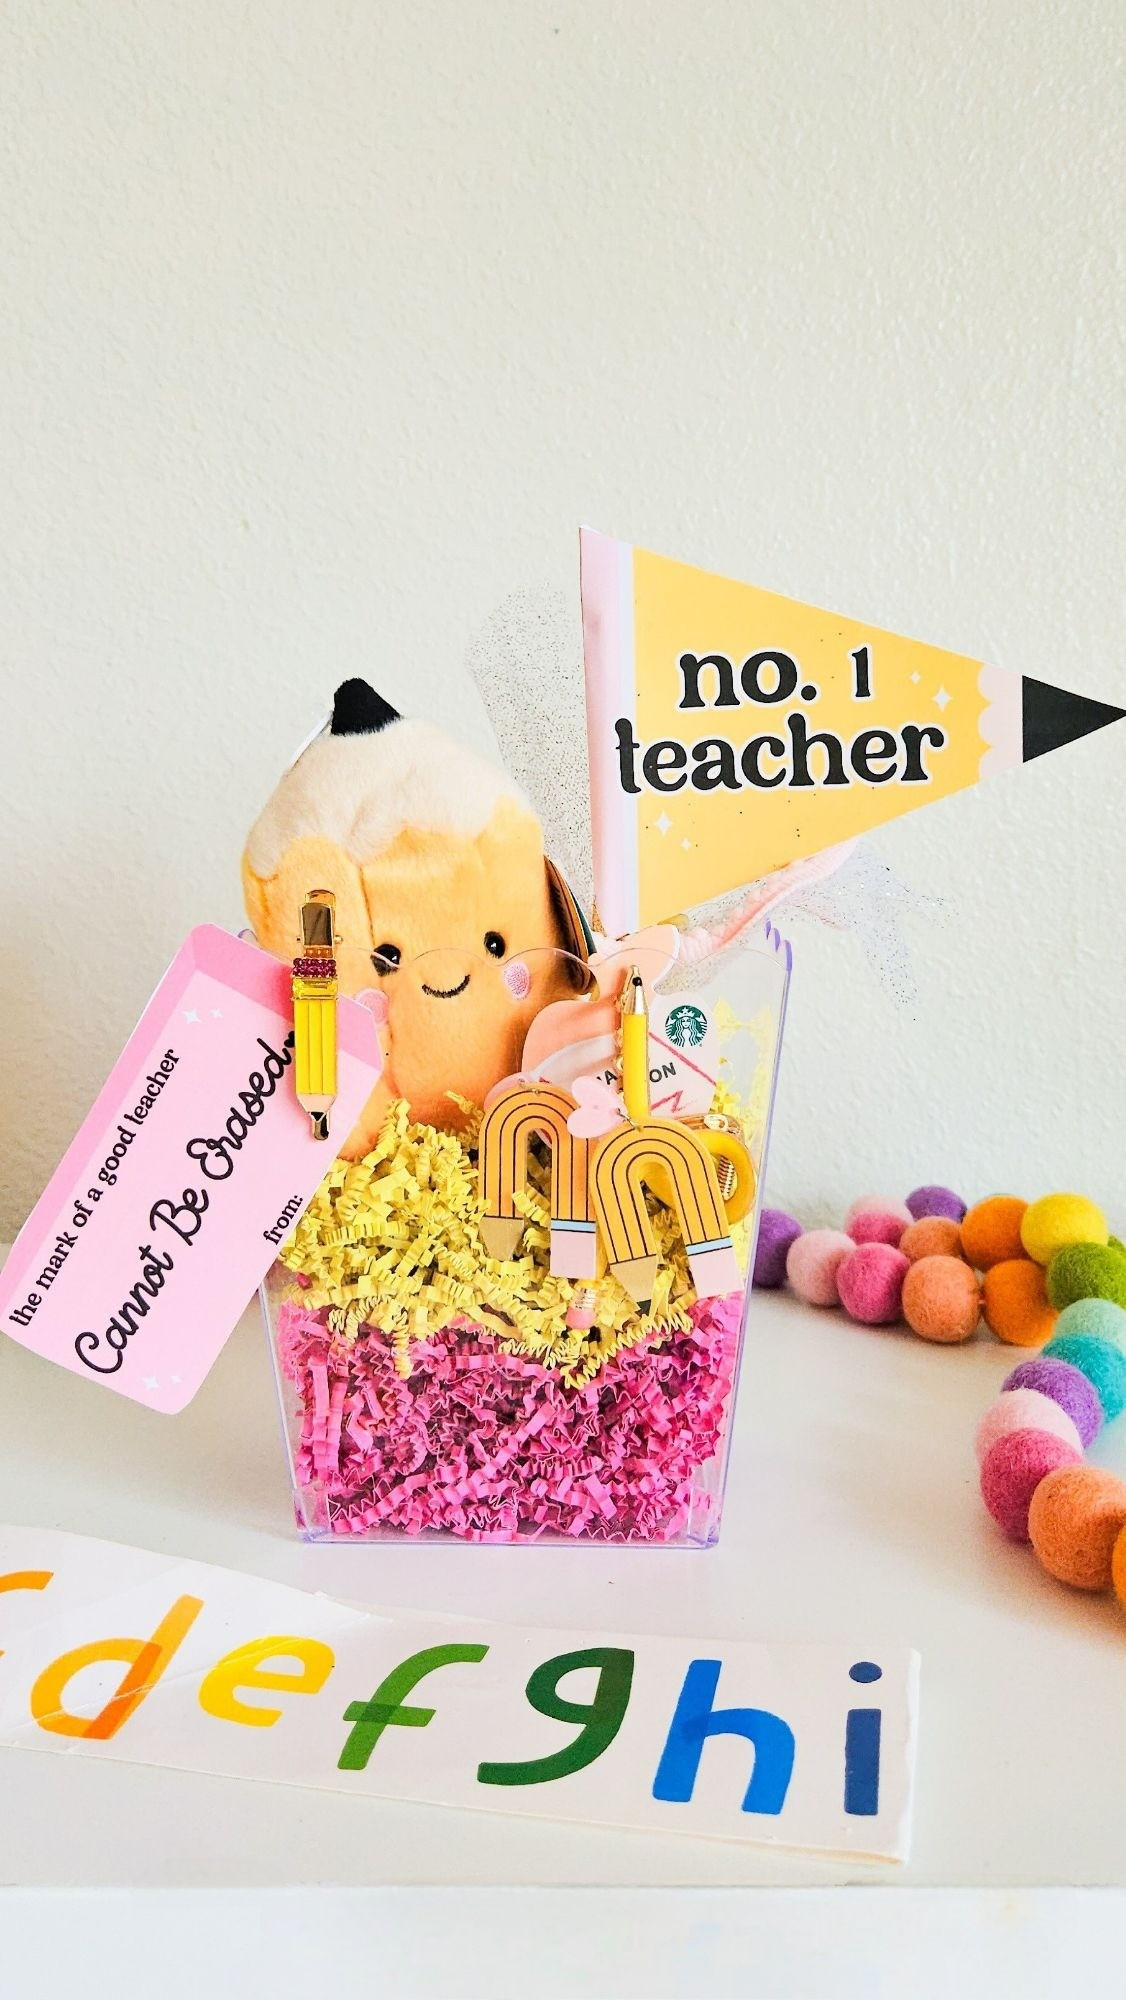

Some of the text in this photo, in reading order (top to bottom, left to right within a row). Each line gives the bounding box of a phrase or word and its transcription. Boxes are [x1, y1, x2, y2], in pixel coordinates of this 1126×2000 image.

[614, 712, 944, 793] teacher
[679, 646, 871, 708] no. 1
[9, 1048, 179, 1326] the mark of a good teacher
[74, 1038, 292, 1374] Cannot Be Erased
[262, 1195, 303, 1246] from:
[30, 1595, 203, 1740] d
[198, 1636, 335, 1728] e
[338, 1643, 489, 1771] f
[478, 1648, 635, 1786] g
[653, 1659, 796, 1816] h
[844, 1661, 882, 1816] i
